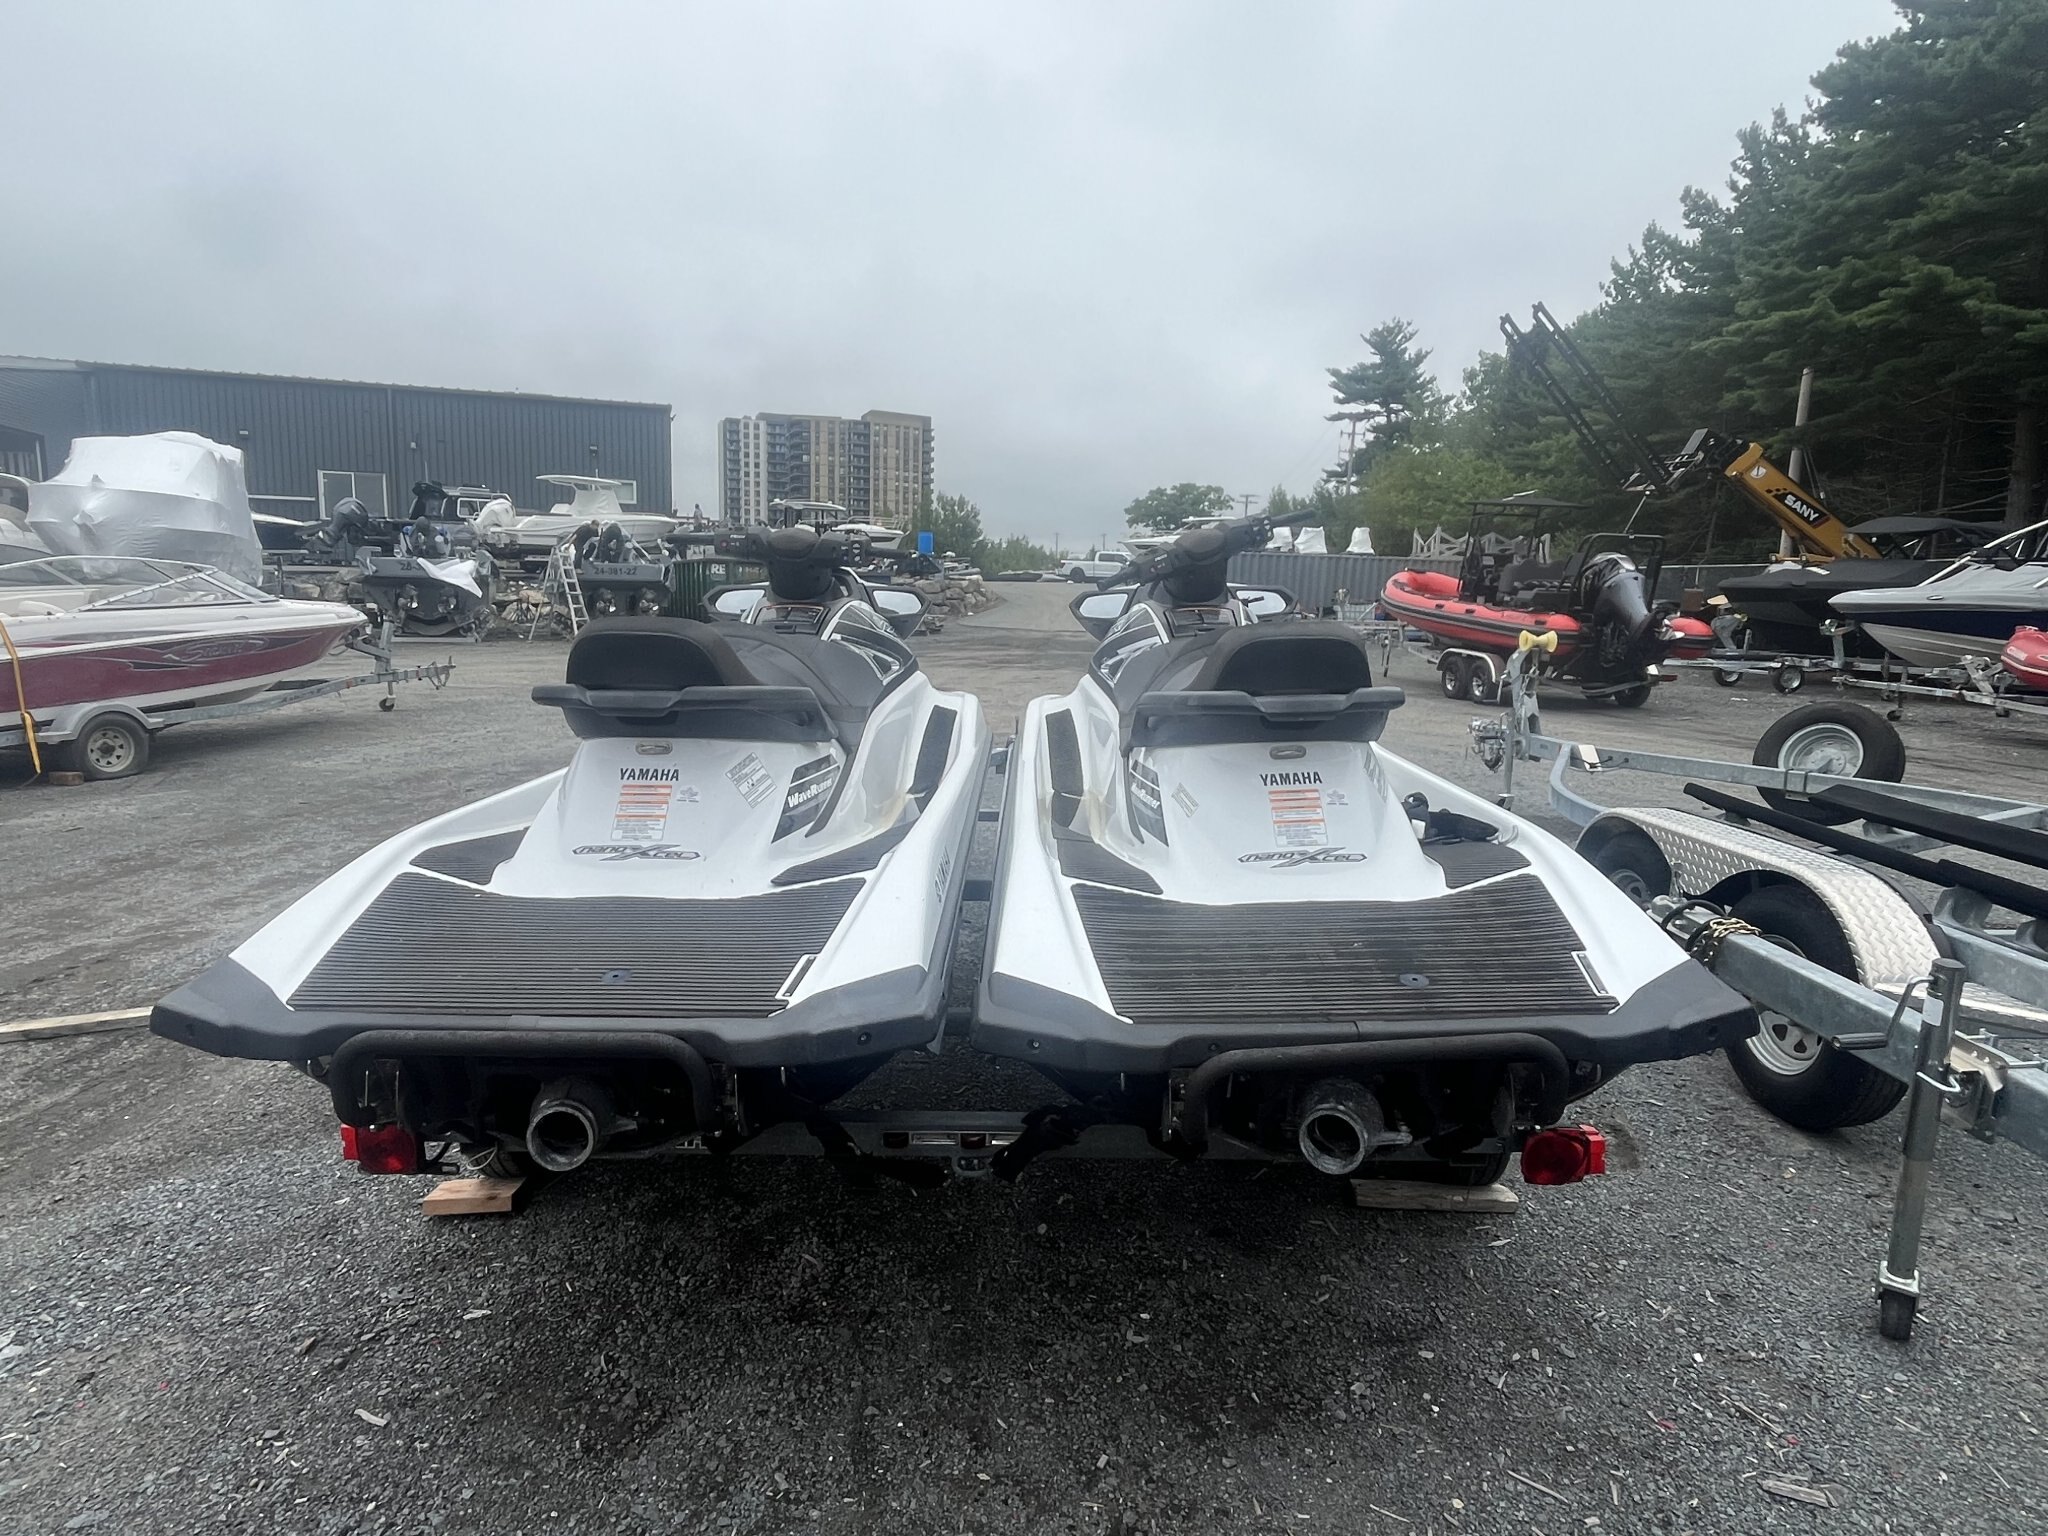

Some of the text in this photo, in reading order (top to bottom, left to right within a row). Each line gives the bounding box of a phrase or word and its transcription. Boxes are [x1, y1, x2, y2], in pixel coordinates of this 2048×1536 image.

[1784, 494, 1820, 521] SANY
[620, 767, 680, 781] YAMAHA
[1260, 772, 1323, 786] YAMAHA
